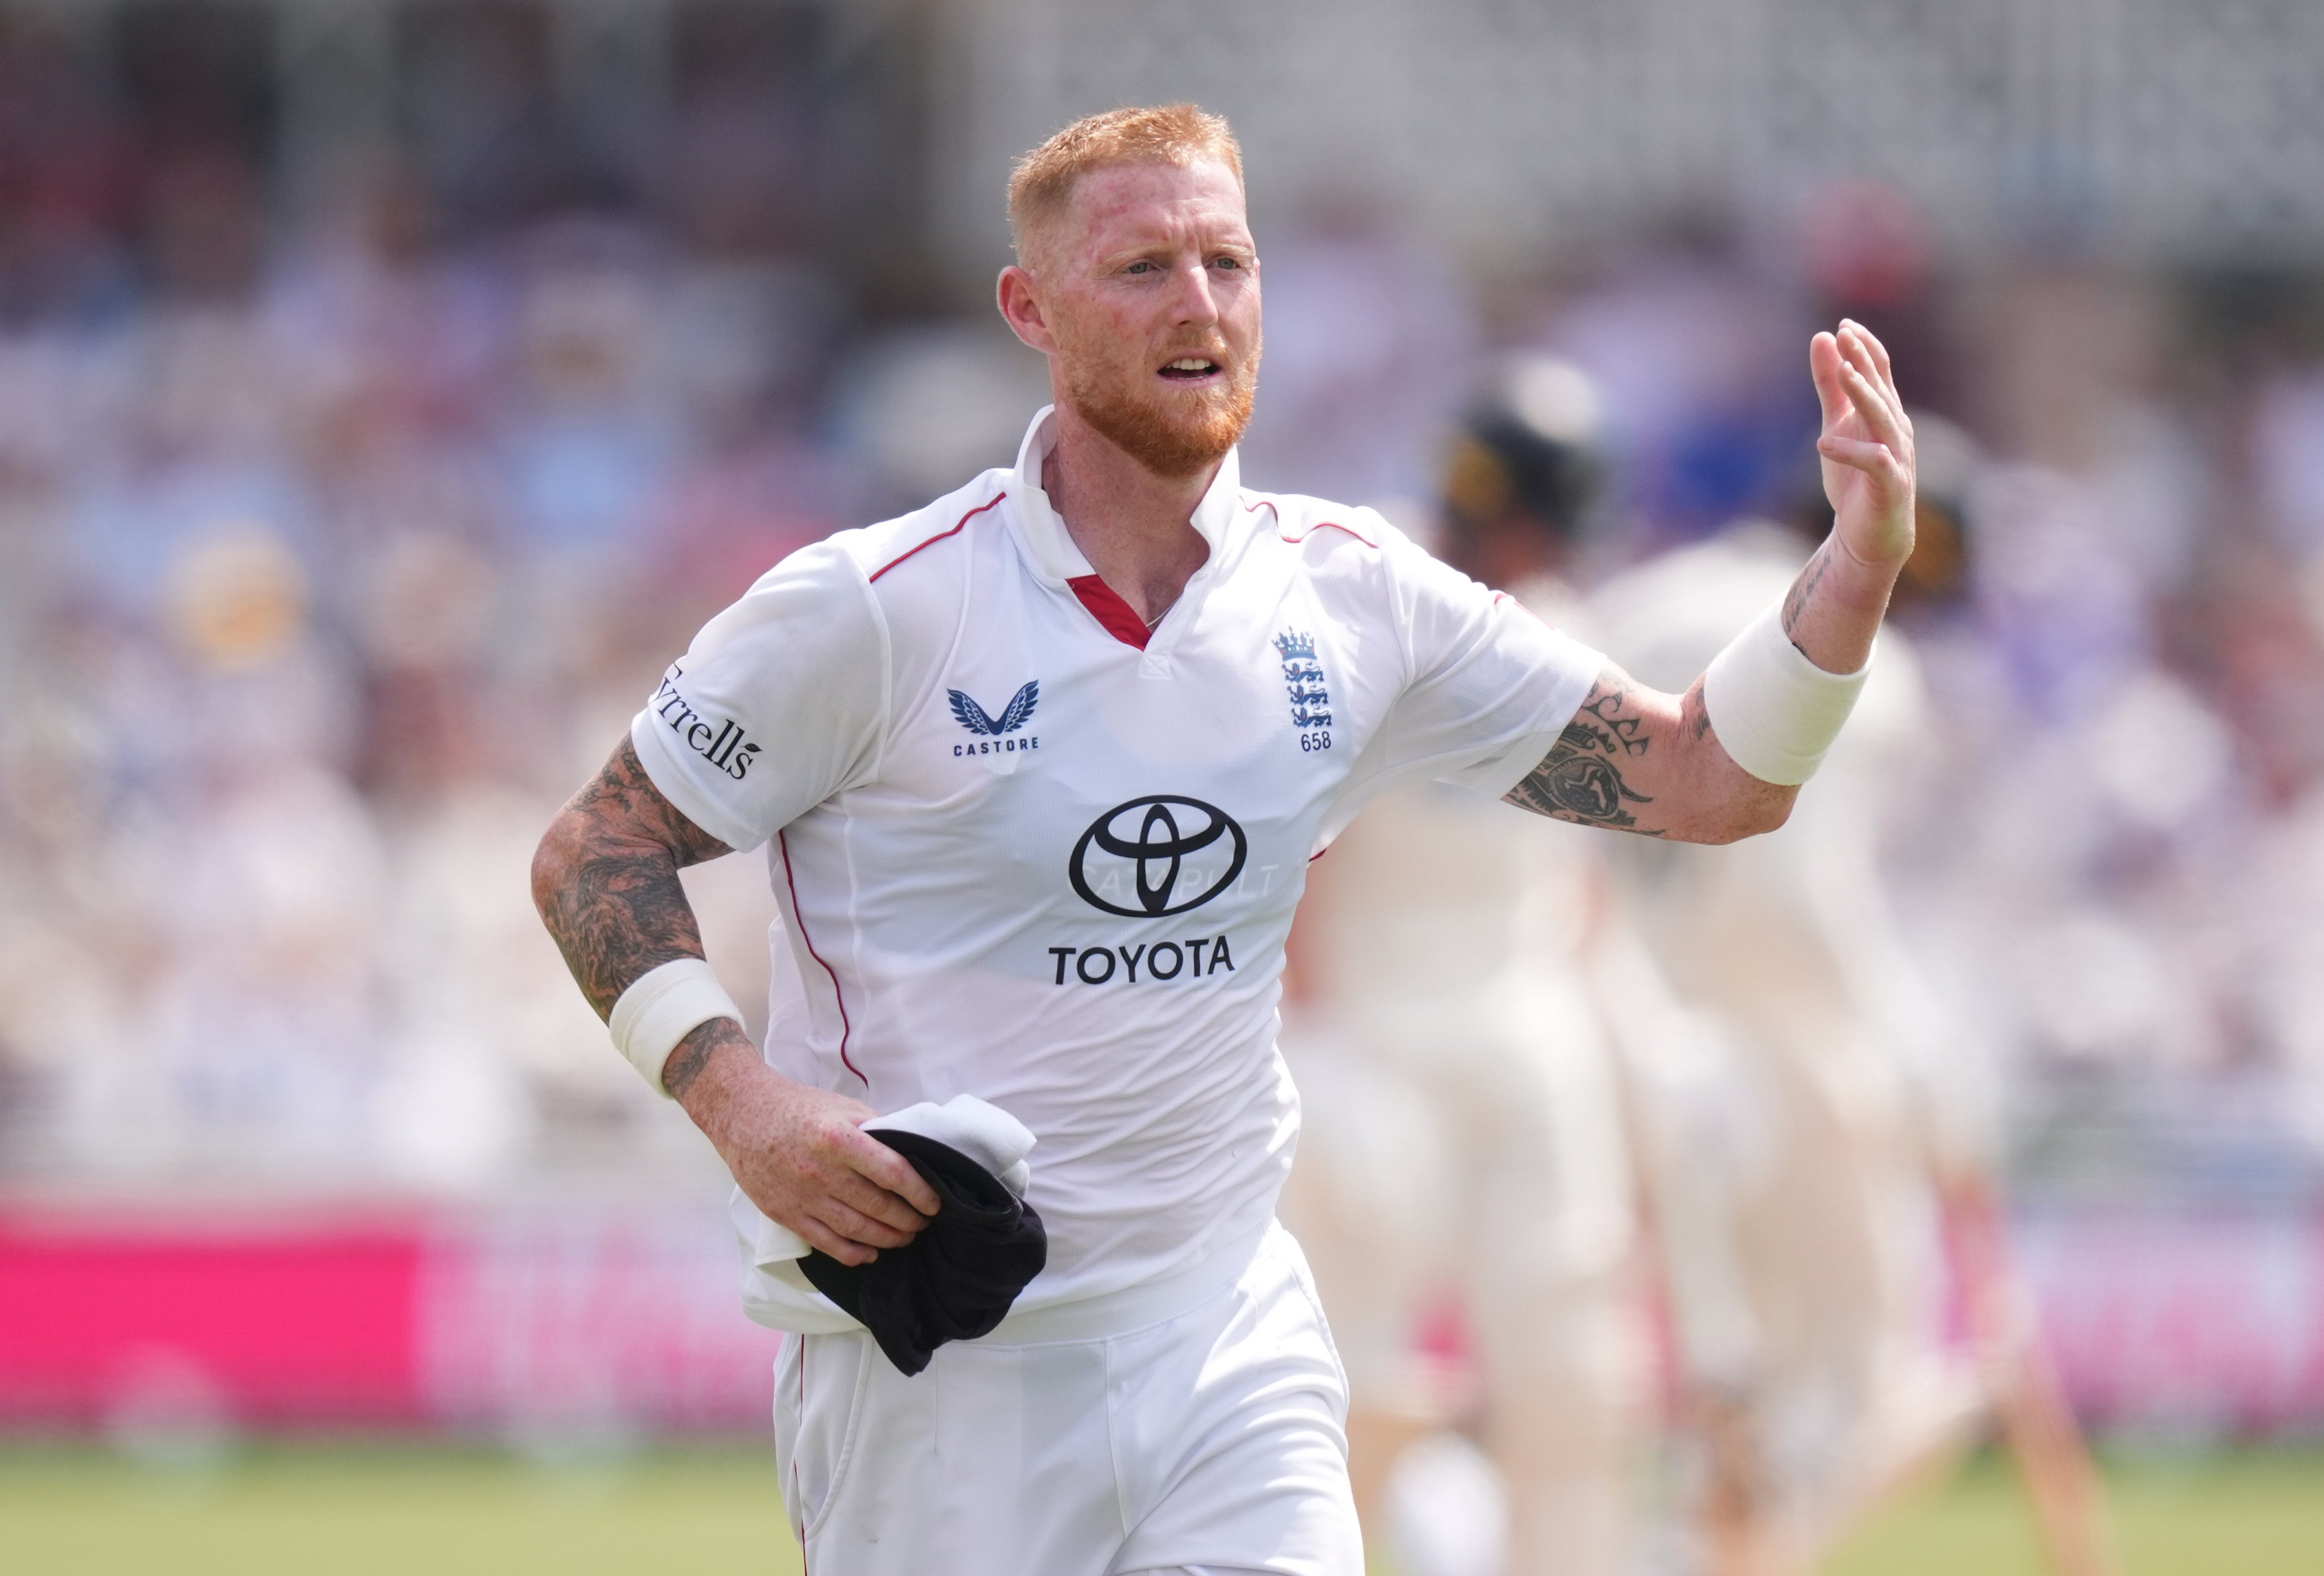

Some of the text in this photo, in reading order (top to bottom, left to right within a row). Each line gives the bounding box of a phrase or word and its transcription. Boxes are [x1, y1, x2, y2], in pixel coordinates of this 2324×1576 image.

[648, 662, 753, 780] yrrells
[953, 737, 1039, 757] CASTORE
[1301, 731, 1331, 752] 658
[1048, 935, 1236, 985] TOYOTA
